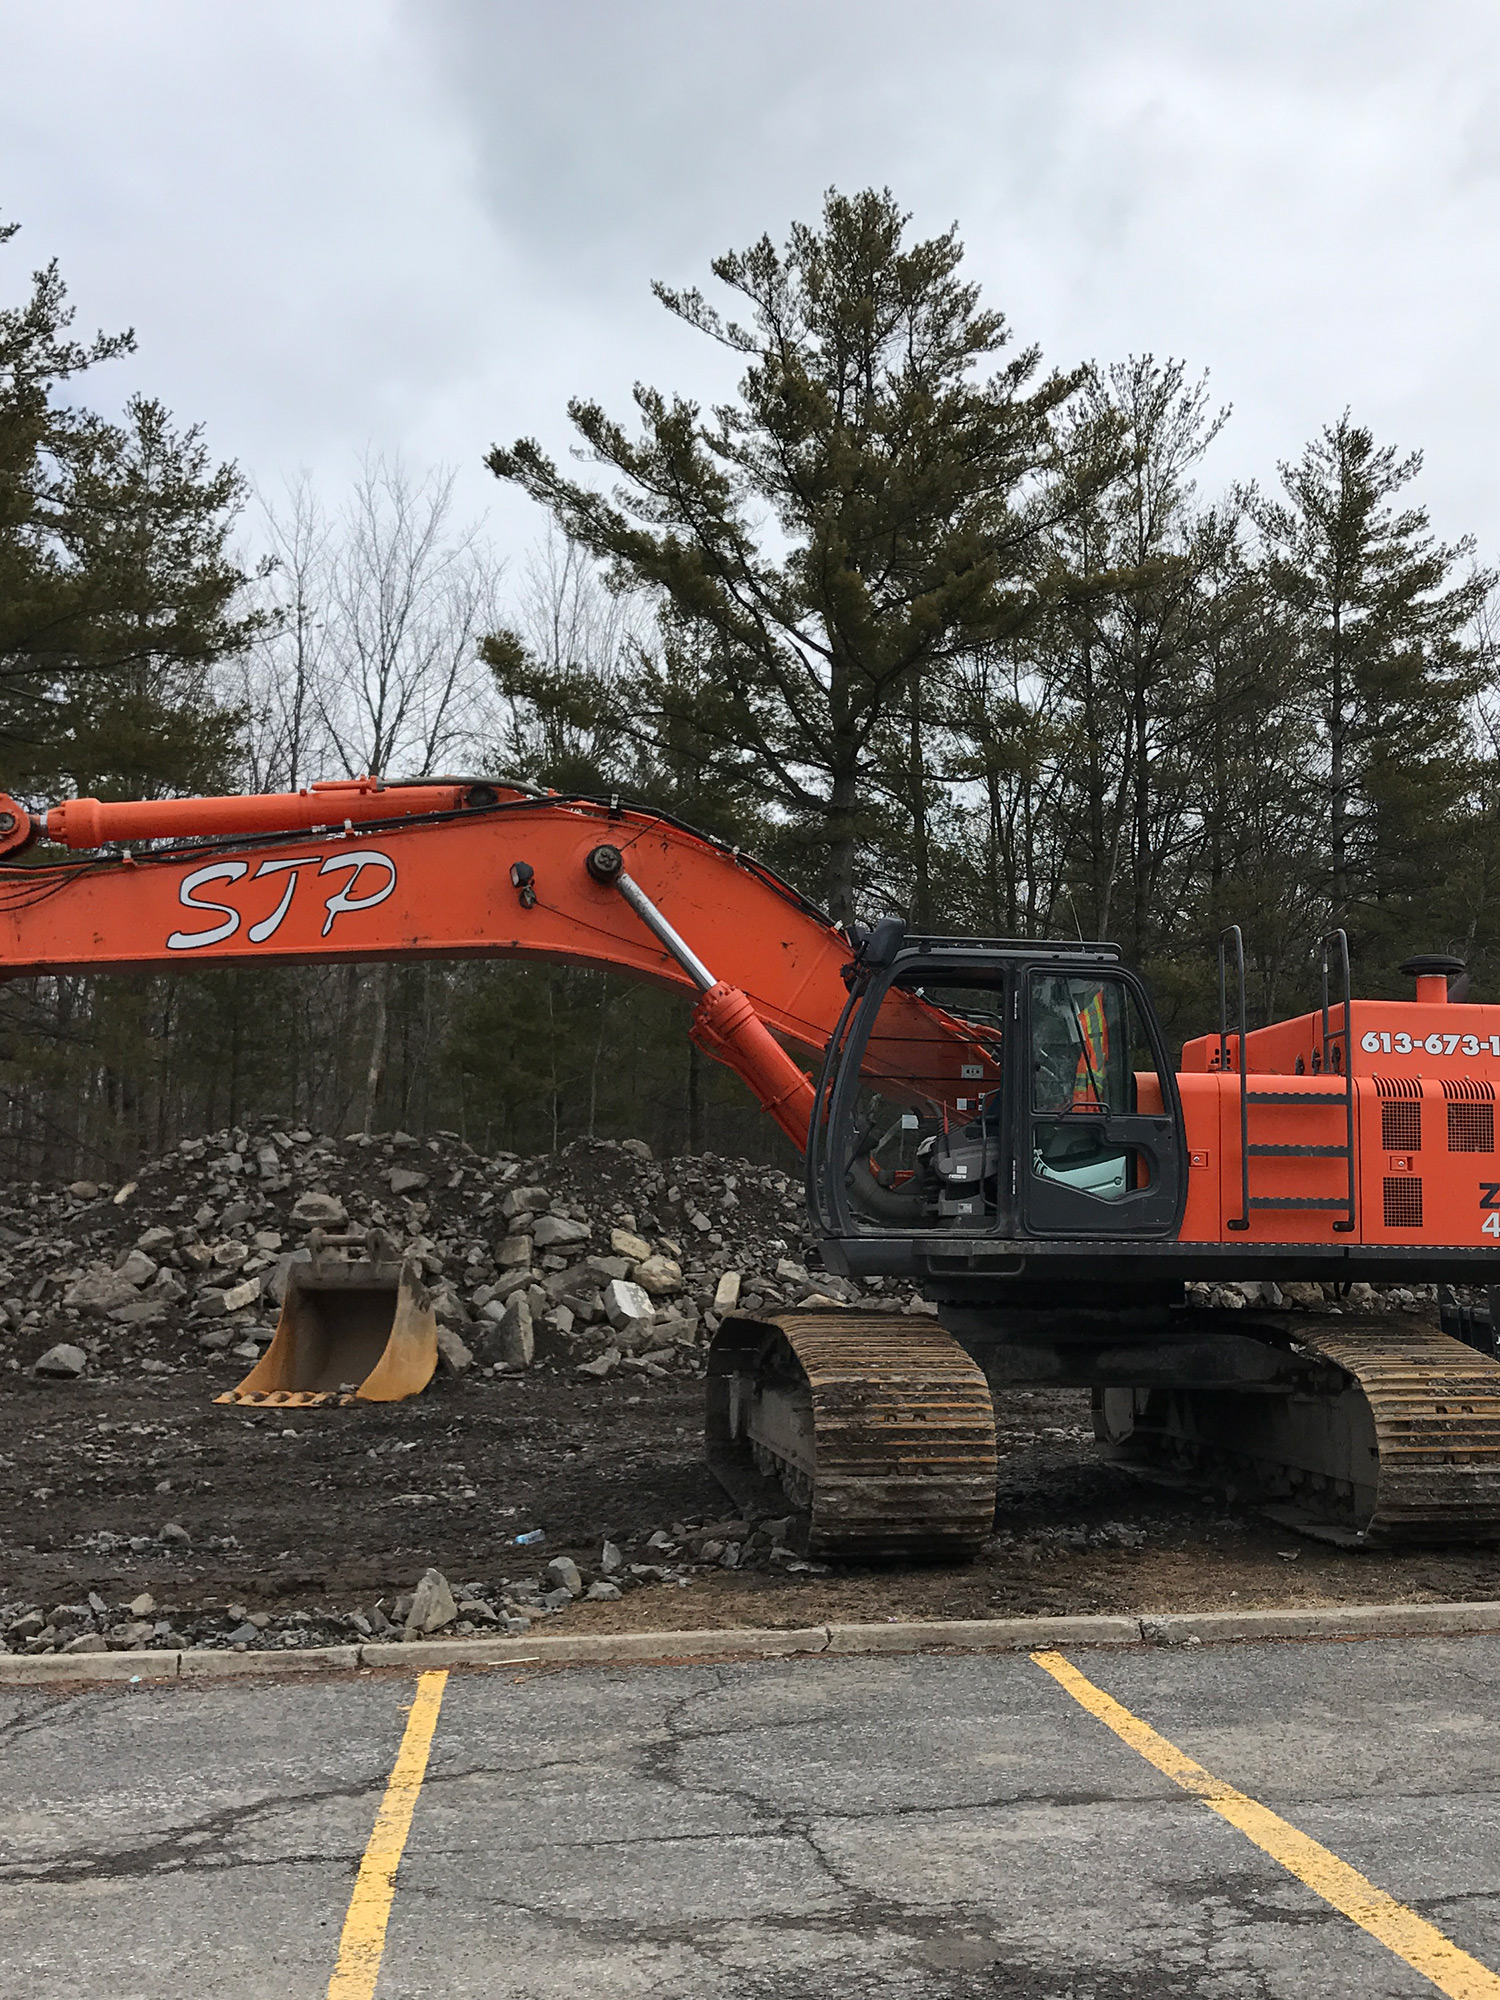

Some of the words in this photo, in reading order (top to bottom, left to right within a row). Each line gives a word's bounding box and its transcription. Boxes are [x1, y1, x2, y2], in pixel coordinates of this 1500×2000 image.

[1361, 1031, 1500, 1056] 613-673-1
[1479, 1182, 1500, 1209] Z
[1481, 1212, 1500, 1238] 4
